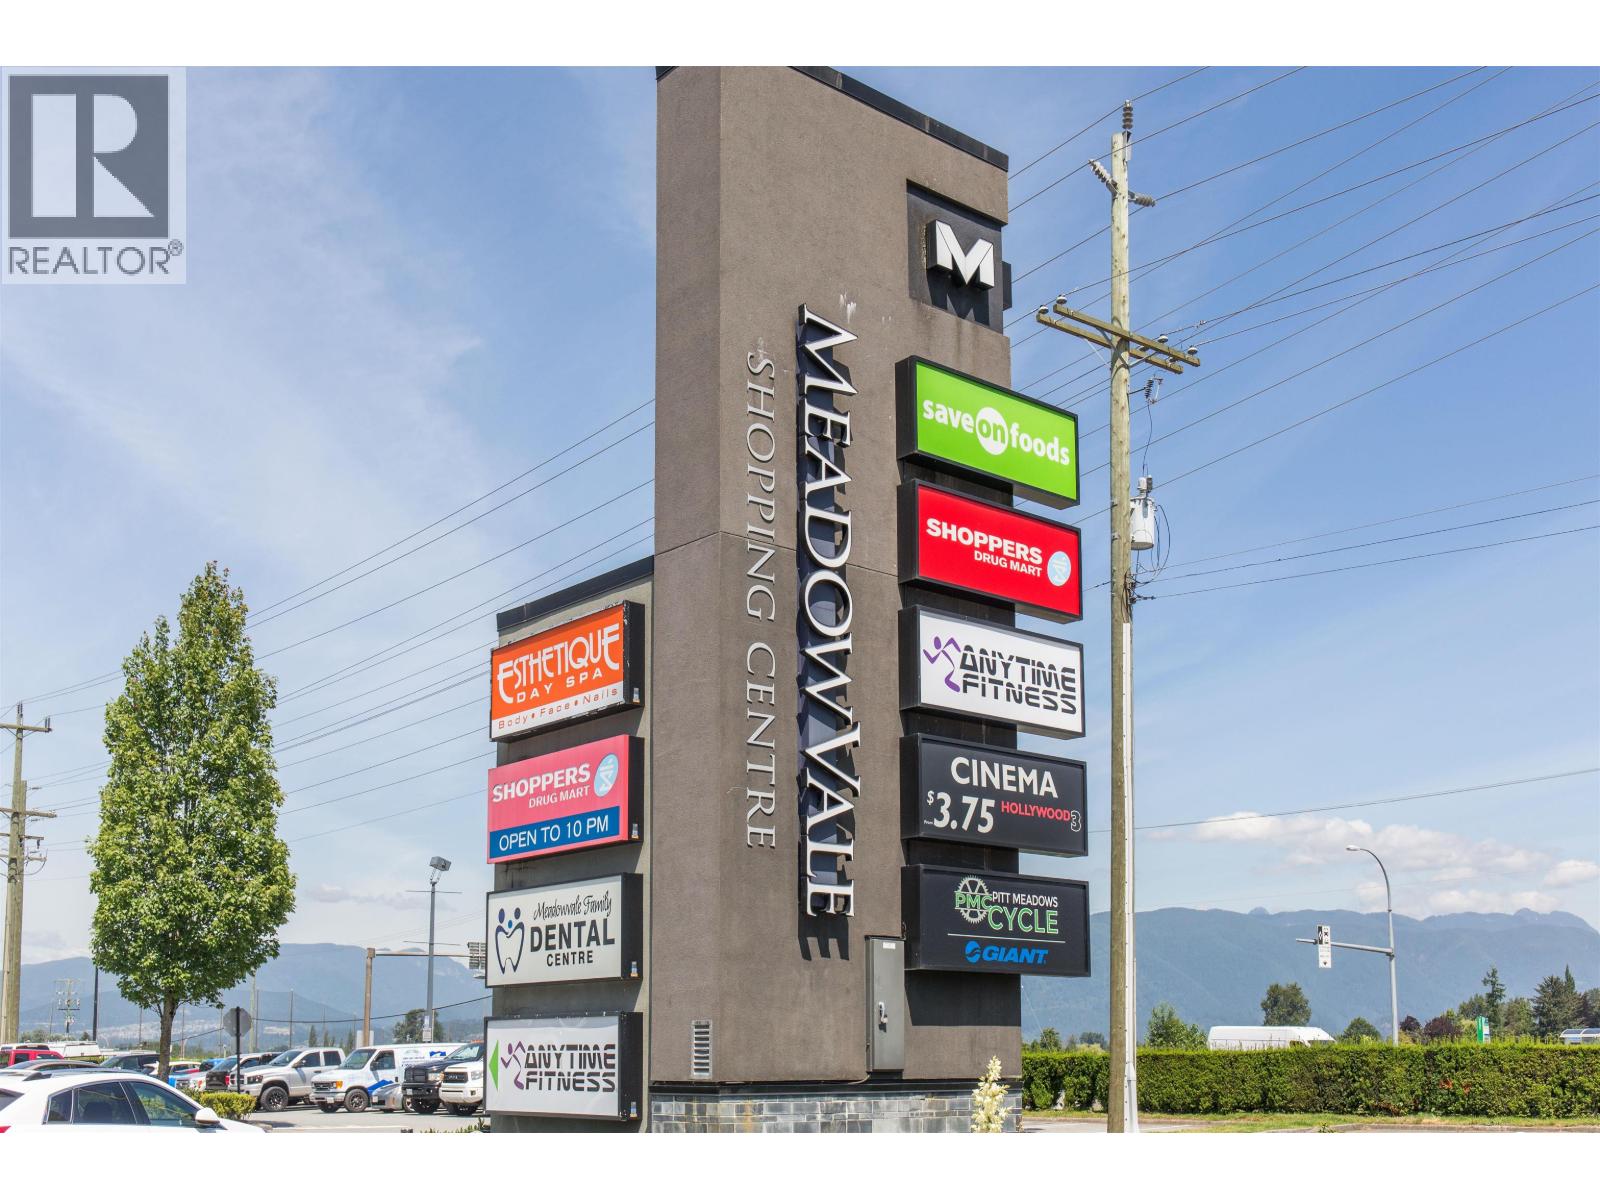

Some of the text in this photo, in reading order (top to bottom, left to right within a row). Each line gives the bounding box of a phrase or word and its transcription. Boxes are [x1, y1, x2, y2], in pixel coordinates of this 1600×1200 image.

[932, 219, 995, 288] M
[926, 517, 1043, 565] SHOPPERS
[974, 550, 1043, 577] DRUG MART
[746, 351, 776, 849] SHOPPING CENTRE
[804, 302, 861, 917] MEADOWVALE
[497, 622, 620, 704] ESTHETIQUE
[959, 645, 1077, 693] ANYTIME
[516, 670, 603, 704] DAY SPA
[962, 672, 1077, 715] FITNESS
[498, 687, 618, 729] Body Face Nails
[492, 763, 591, 803] SHOPPERS
[950, 757, 1059, 799] CINEMA
[528, 785, 591, 809] DRUG MART
[499, 815, 609, 851] OPEN TO 10 PM
[533, 890, 612, 920] Meadowvale Family
[954, 892, 993, 910] PMC
[992, 891, 1059, 908] PITT MEADOWS
[530, 918, 616, 953] DENTAL
[987, 905, 1059, 935] CYCLE
[546, 950, 594, 967] CENTRE
[982, 945, 1049, 964] GIANT
[524, 1043, 616, 1070] ANYTIME
[525, 1071, 616, 1093] FITNESS
